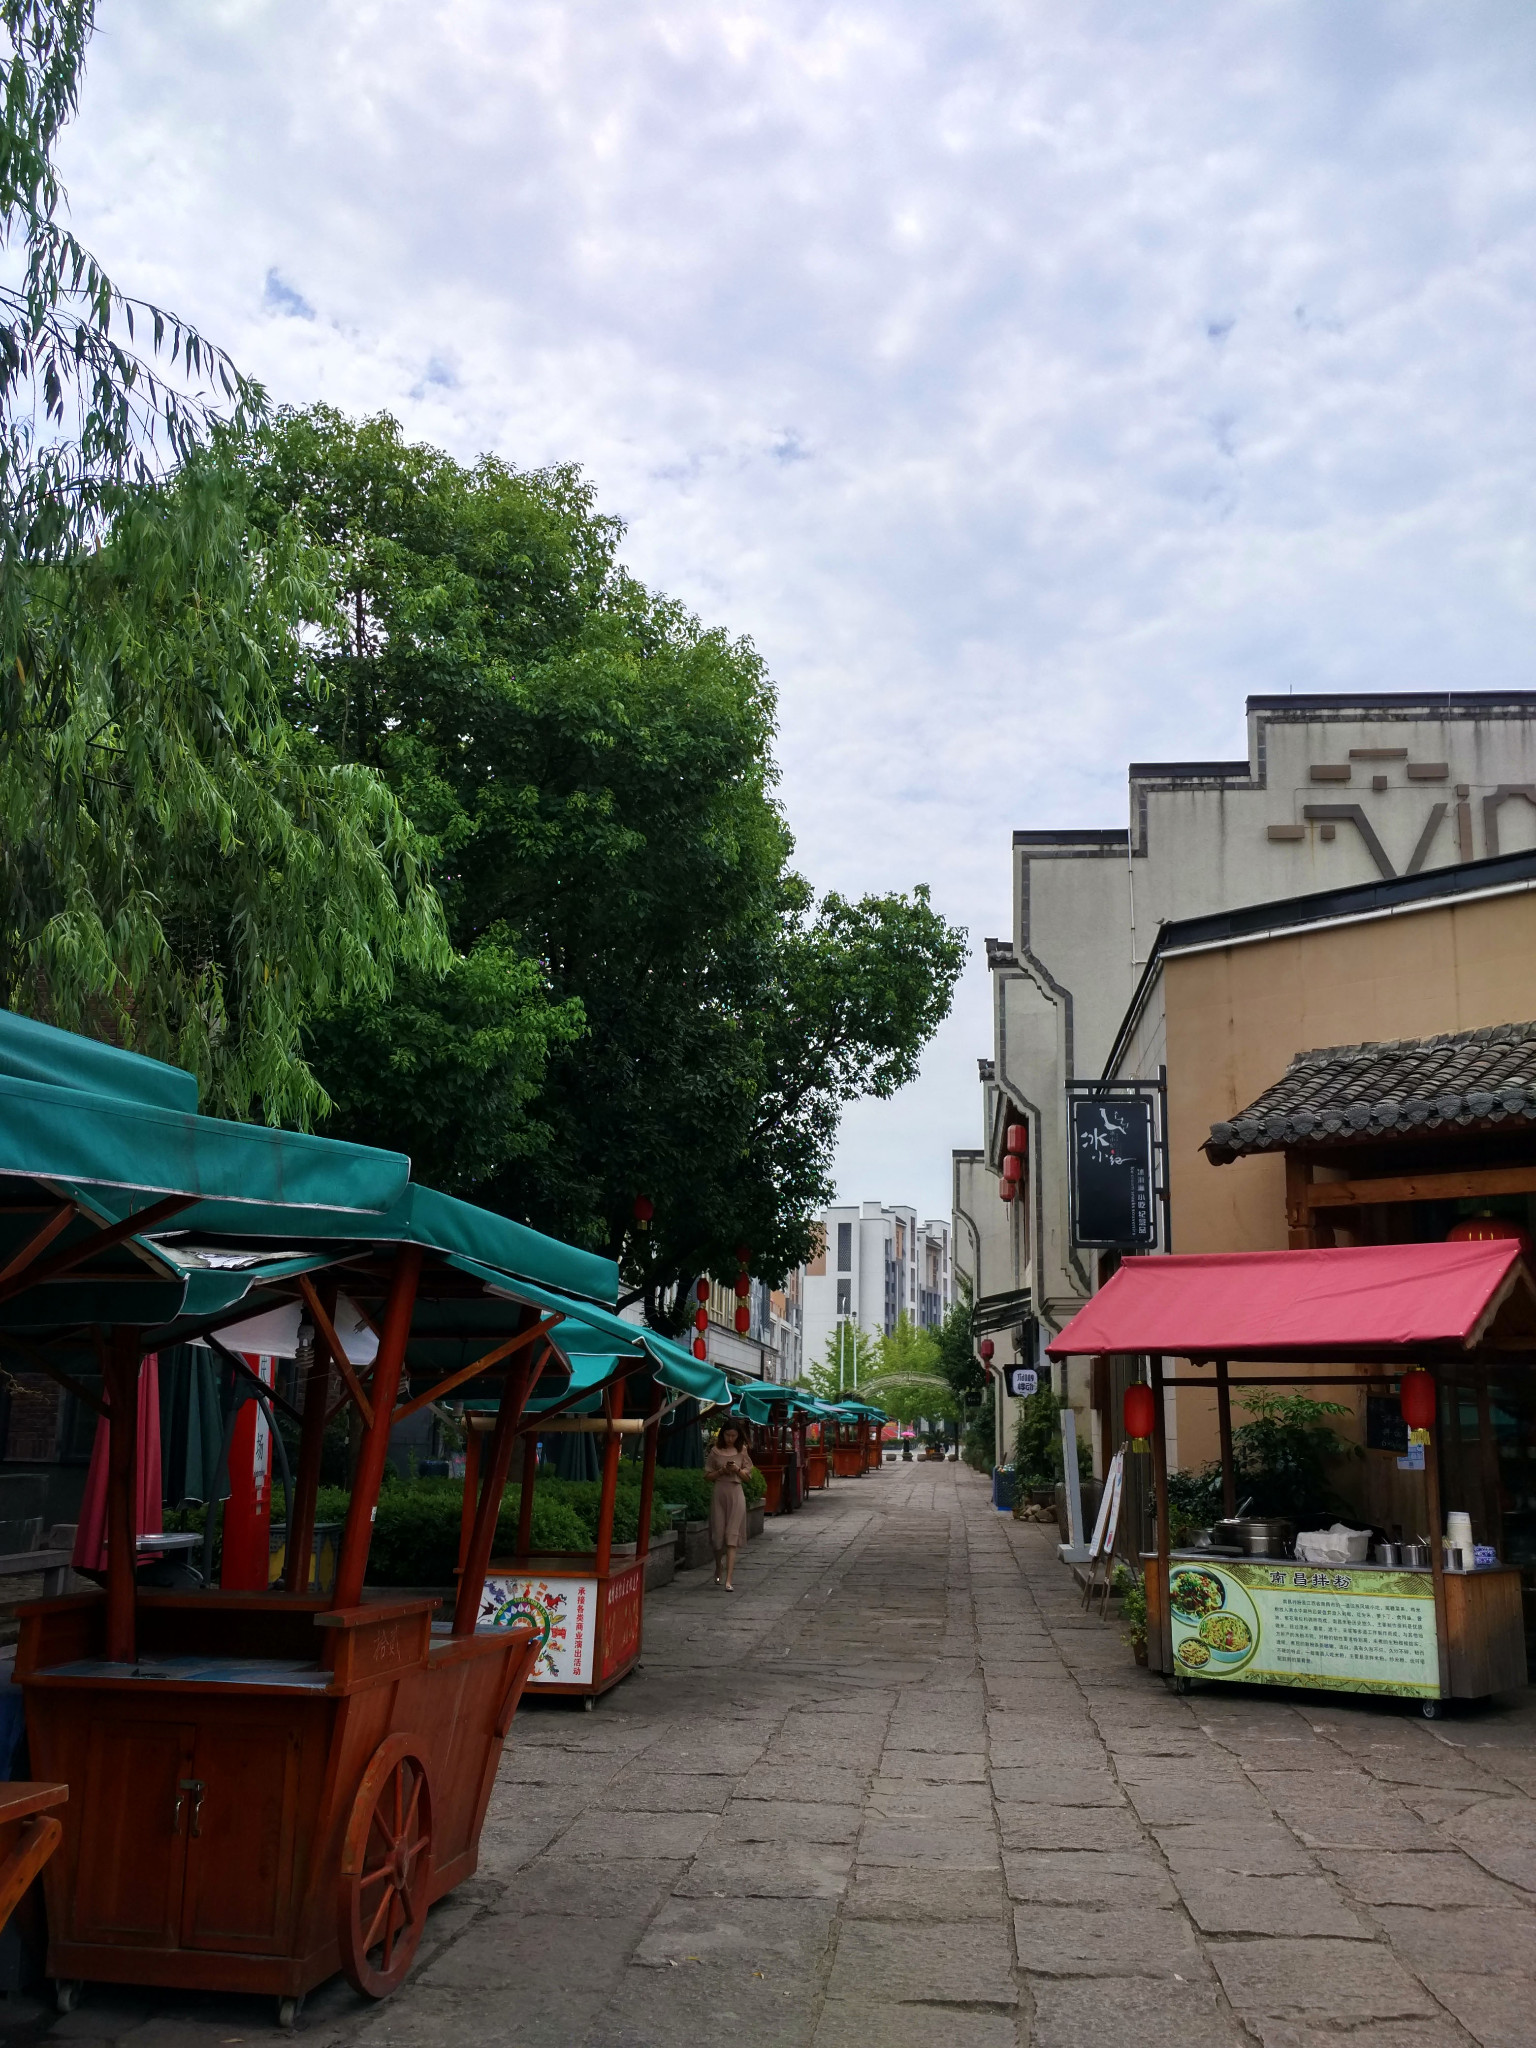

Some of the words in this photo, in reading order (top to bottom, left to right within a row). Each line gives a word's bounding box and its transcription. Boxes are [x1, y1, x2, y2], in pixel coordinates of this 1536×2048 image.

[1269, 1571, 1352, 1589] 南昌拌粉
[572, 1586, 586, 1676] 承接各类商业演出活动
